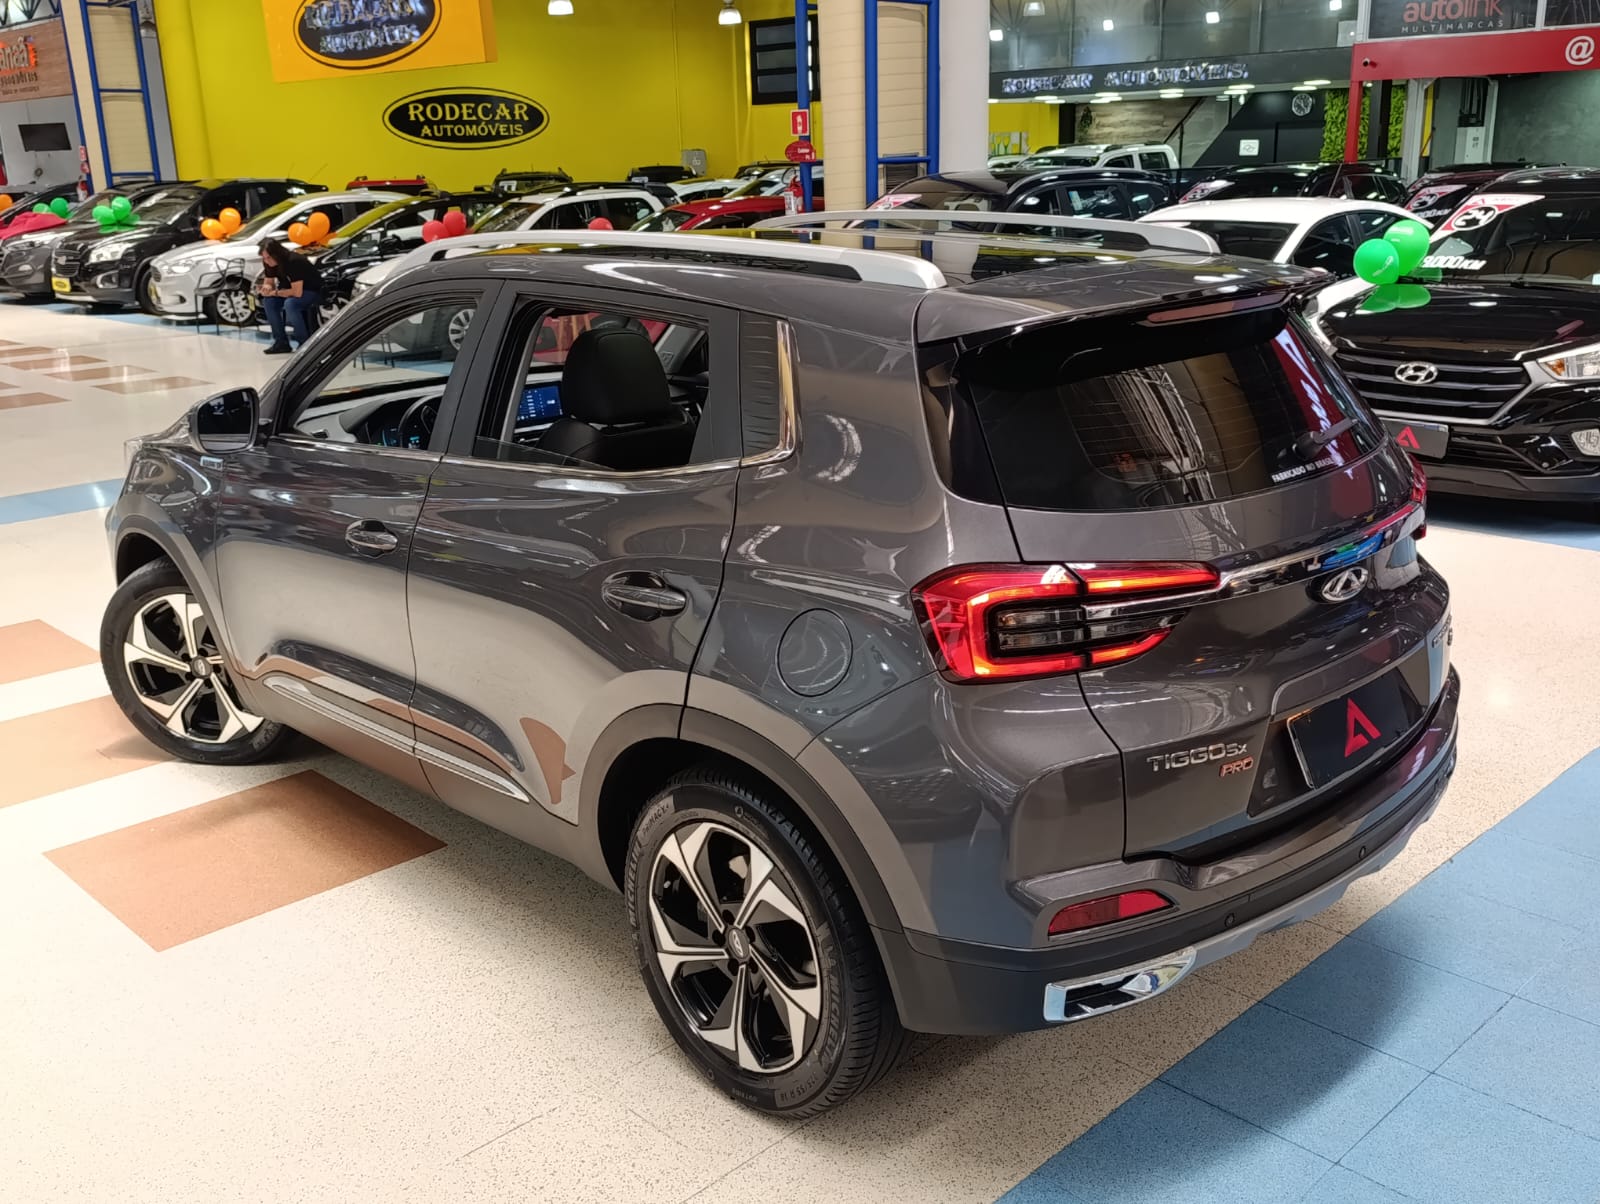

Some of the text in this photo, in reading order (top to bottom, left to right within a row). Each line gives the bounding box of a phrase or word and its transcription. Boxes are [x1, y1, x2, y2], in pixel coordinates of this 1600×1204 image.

[1401, 20, 1504, 33] MULTIMARCAS
[408, 102, 530, 122] RODECAR
[420, 122, 524, 137] AUTOMÓVEIS
[1454, 208, 1495, 228] 24
[1272, 465, 1306, 482] FABRICADO
[1305, 462, 1316, 472] NO
[1219, 756, 1254, 777] PRO
[627, 837, 642, 927] MICHELIN
